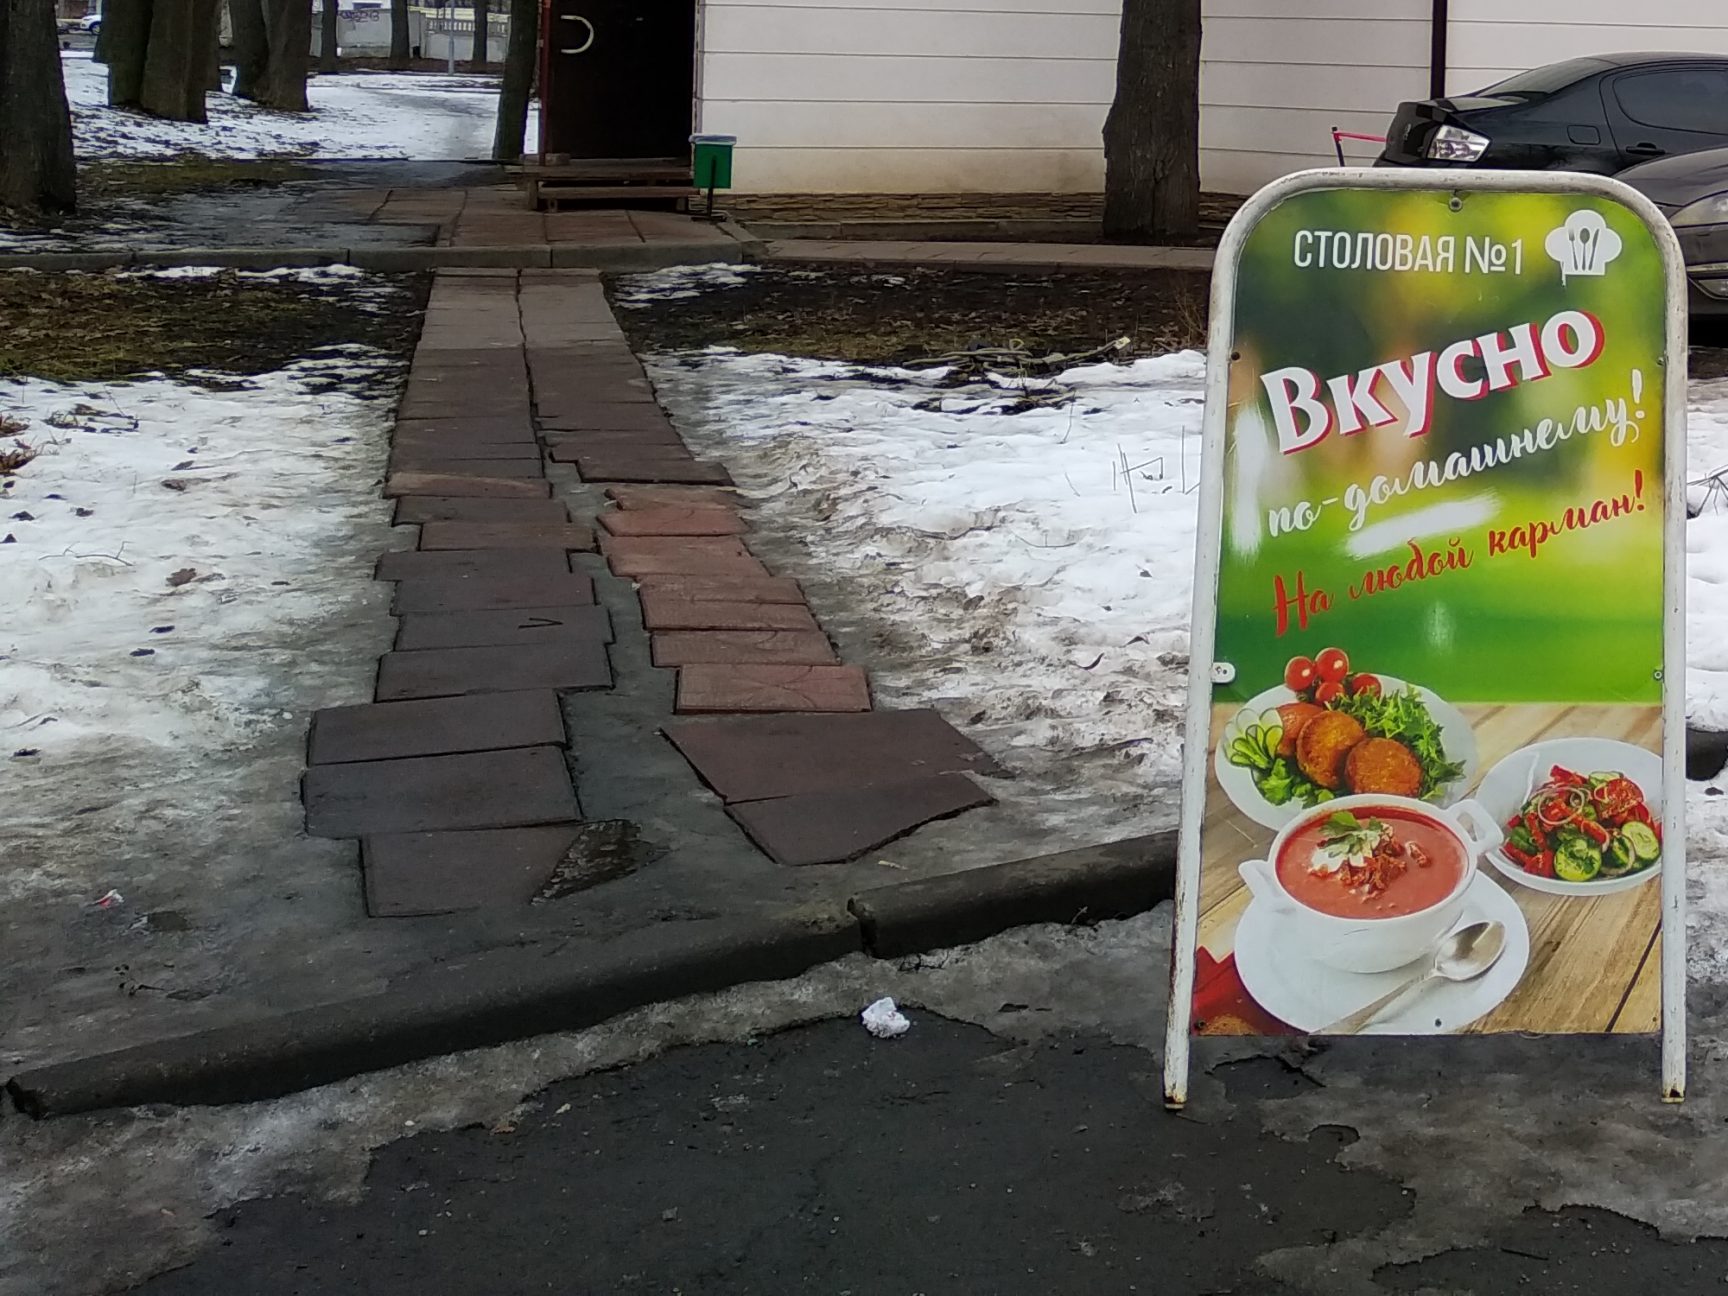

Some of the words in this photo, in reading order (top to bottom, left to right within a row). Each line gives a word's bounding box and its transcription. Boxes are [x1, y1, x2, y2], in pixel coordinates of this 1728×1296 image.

[1293, 229, 1455, 274] СТОЛОВАЯ
[1464, 237, 1524, 275] №1
[1268, 369, 1646, 538] по-домашнему!
[1273, 570, 1334, 637] На
[1349, 537, 1474, 601] любой
[1487, 470, 1646, 558] карман!
